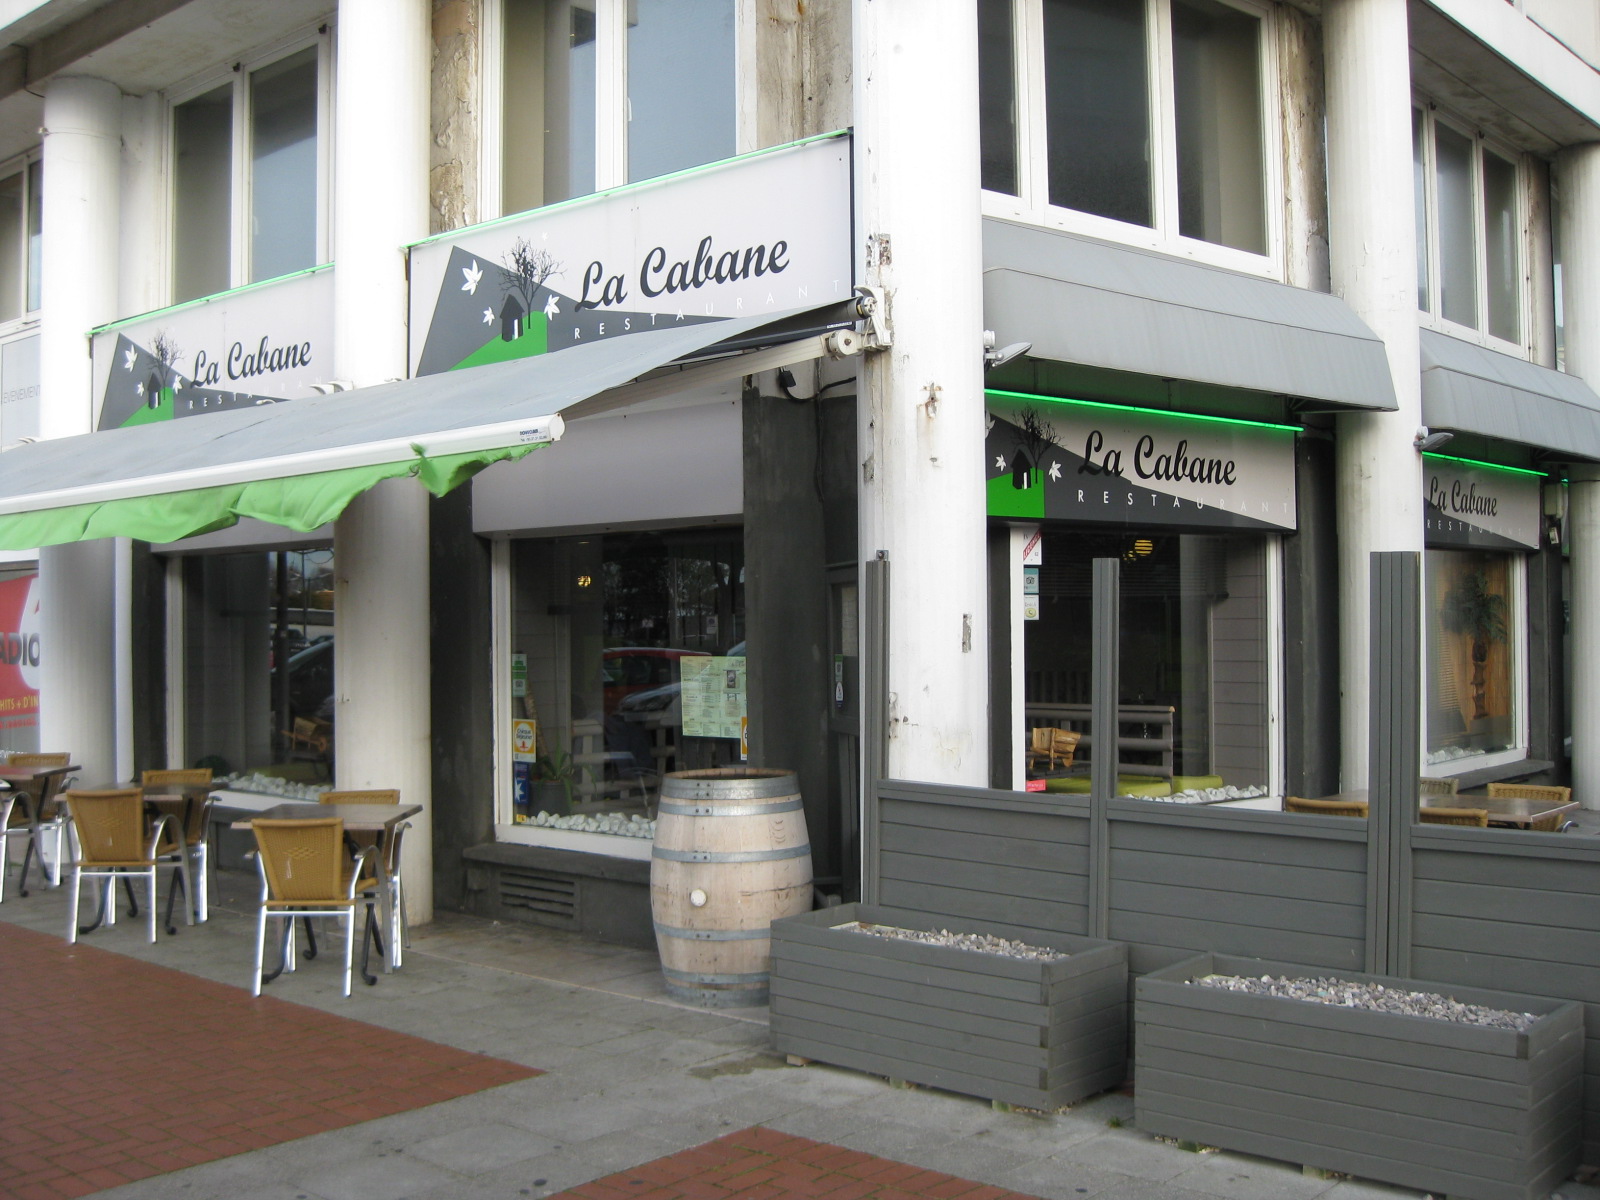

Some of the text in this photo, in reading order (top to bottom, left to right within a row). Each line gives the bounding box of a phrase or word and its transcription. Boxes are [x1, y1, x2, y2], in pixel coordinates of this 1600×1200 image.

[574, 235, 790, 312] La Cabane
[574, 279, 840, 340] RESTAURANT
[190, 335, 312, 388] La Cabane
[1078, 430, 1237, 486] La Cabane
[1077, 489, 1289, 514] RESTAURANT
[1427, 476, 1498, 517] La Cabane
